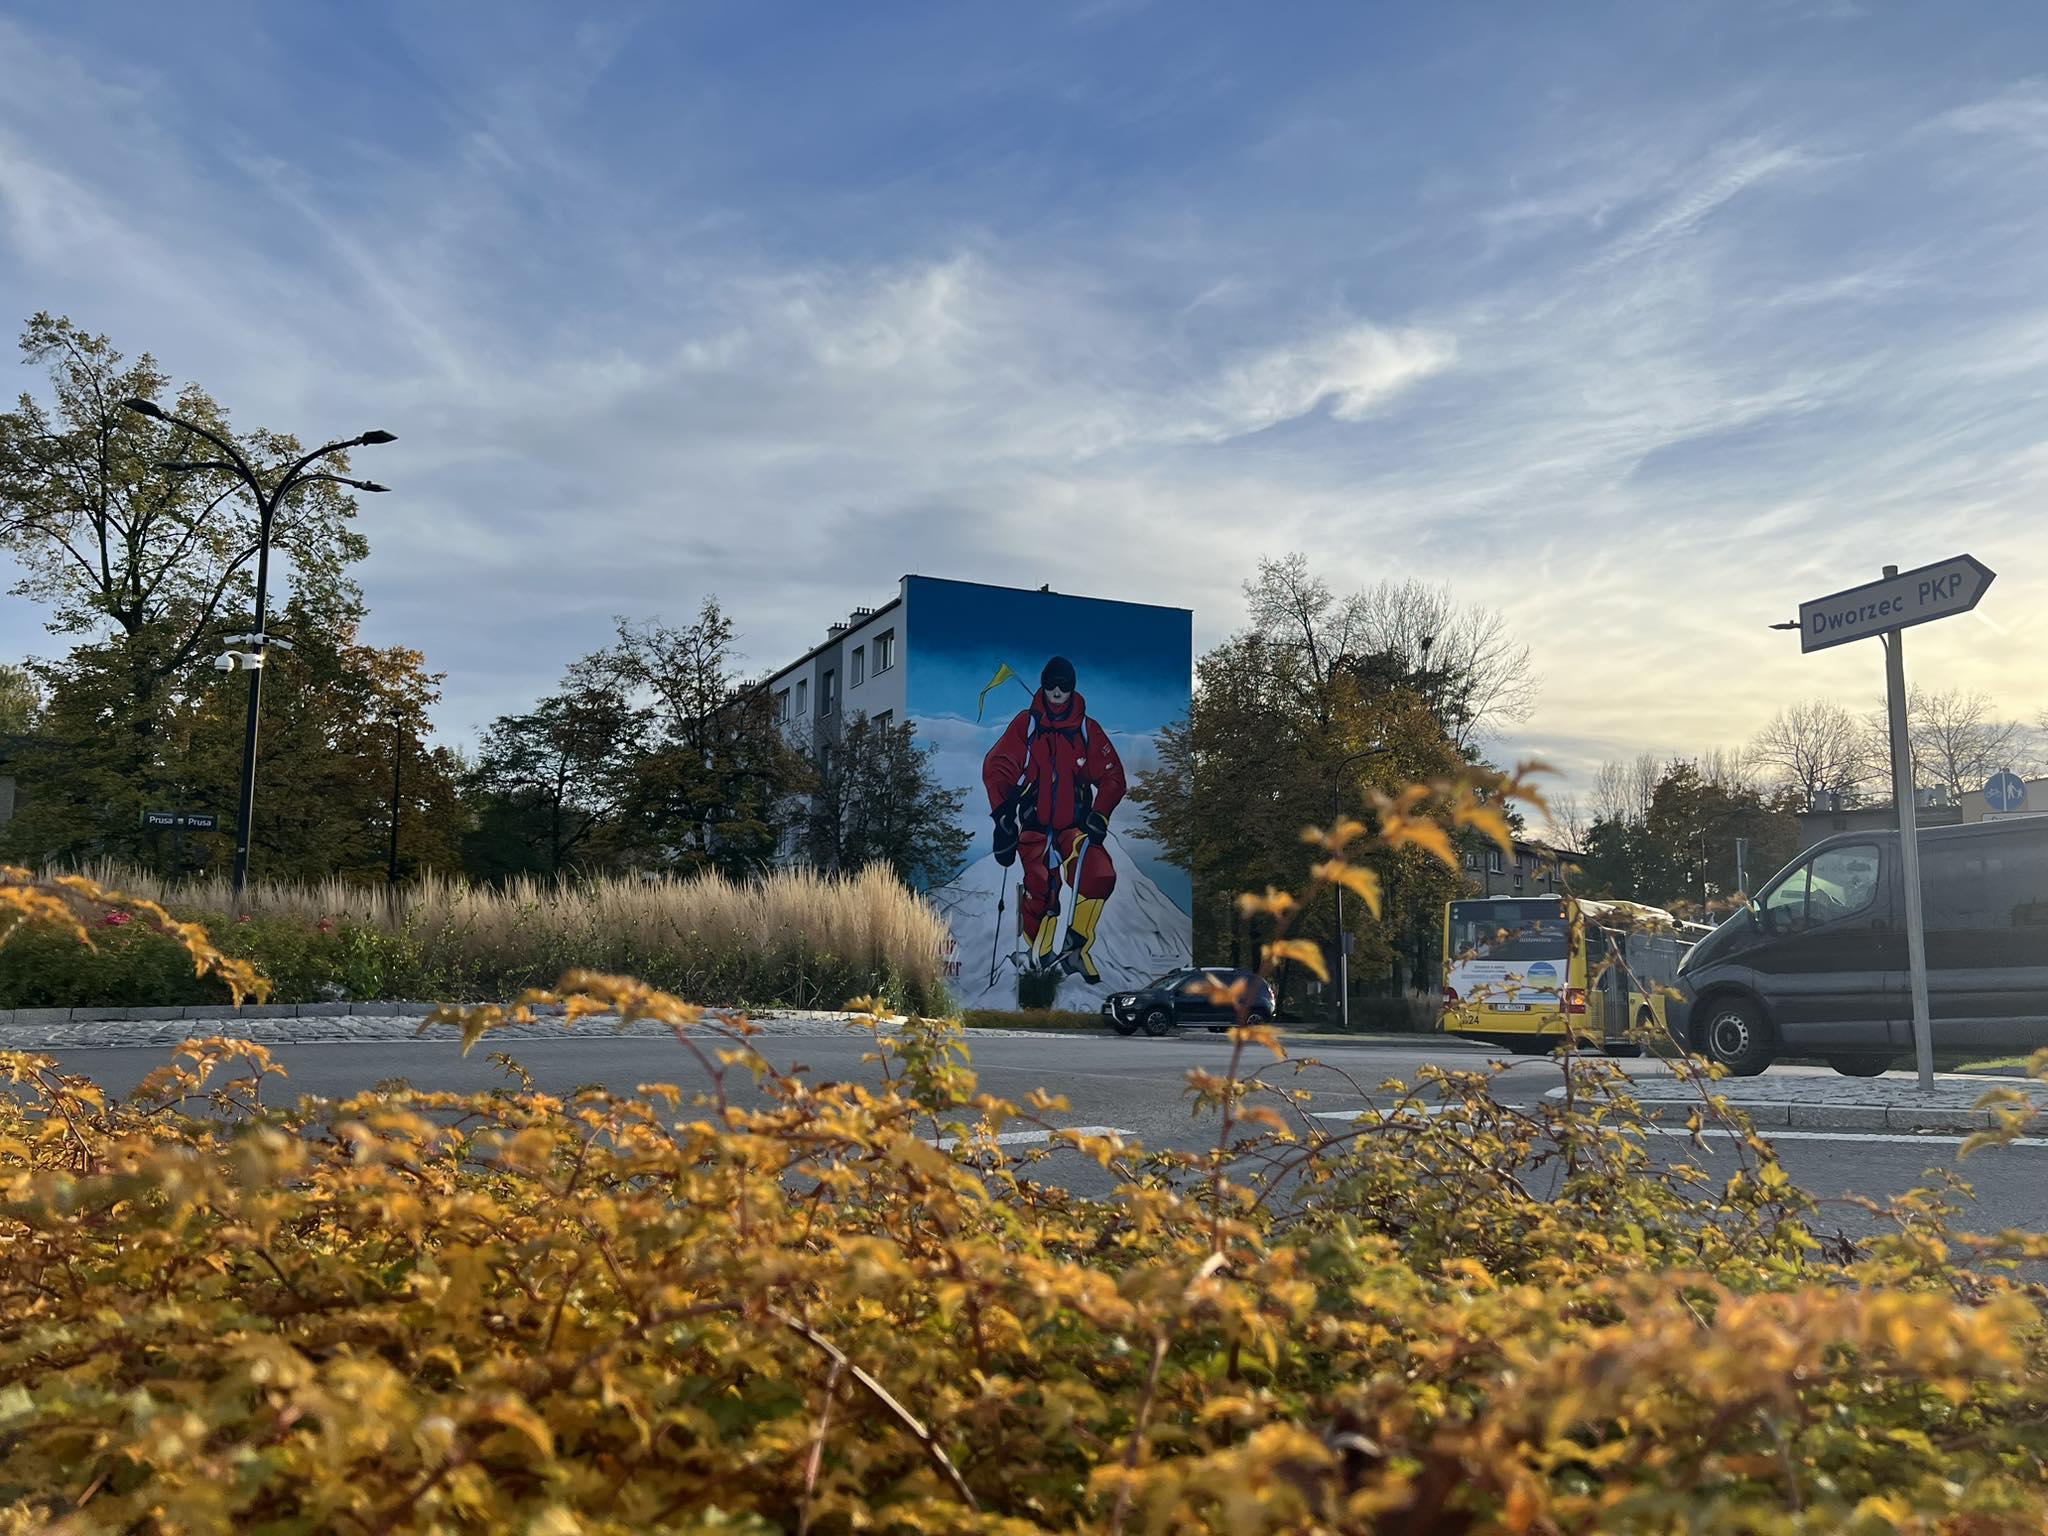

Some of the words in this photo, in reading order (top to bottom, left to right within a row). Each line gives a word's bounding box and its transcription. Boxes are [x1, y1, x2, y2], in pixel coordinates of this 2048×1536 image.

[1812, 596, 1904, 635] Dworzec
[1918, 572, 1963, 606] PKP
[149, 815, 173, 825] Prusa
[188, 817, 212, 827] Prusa
